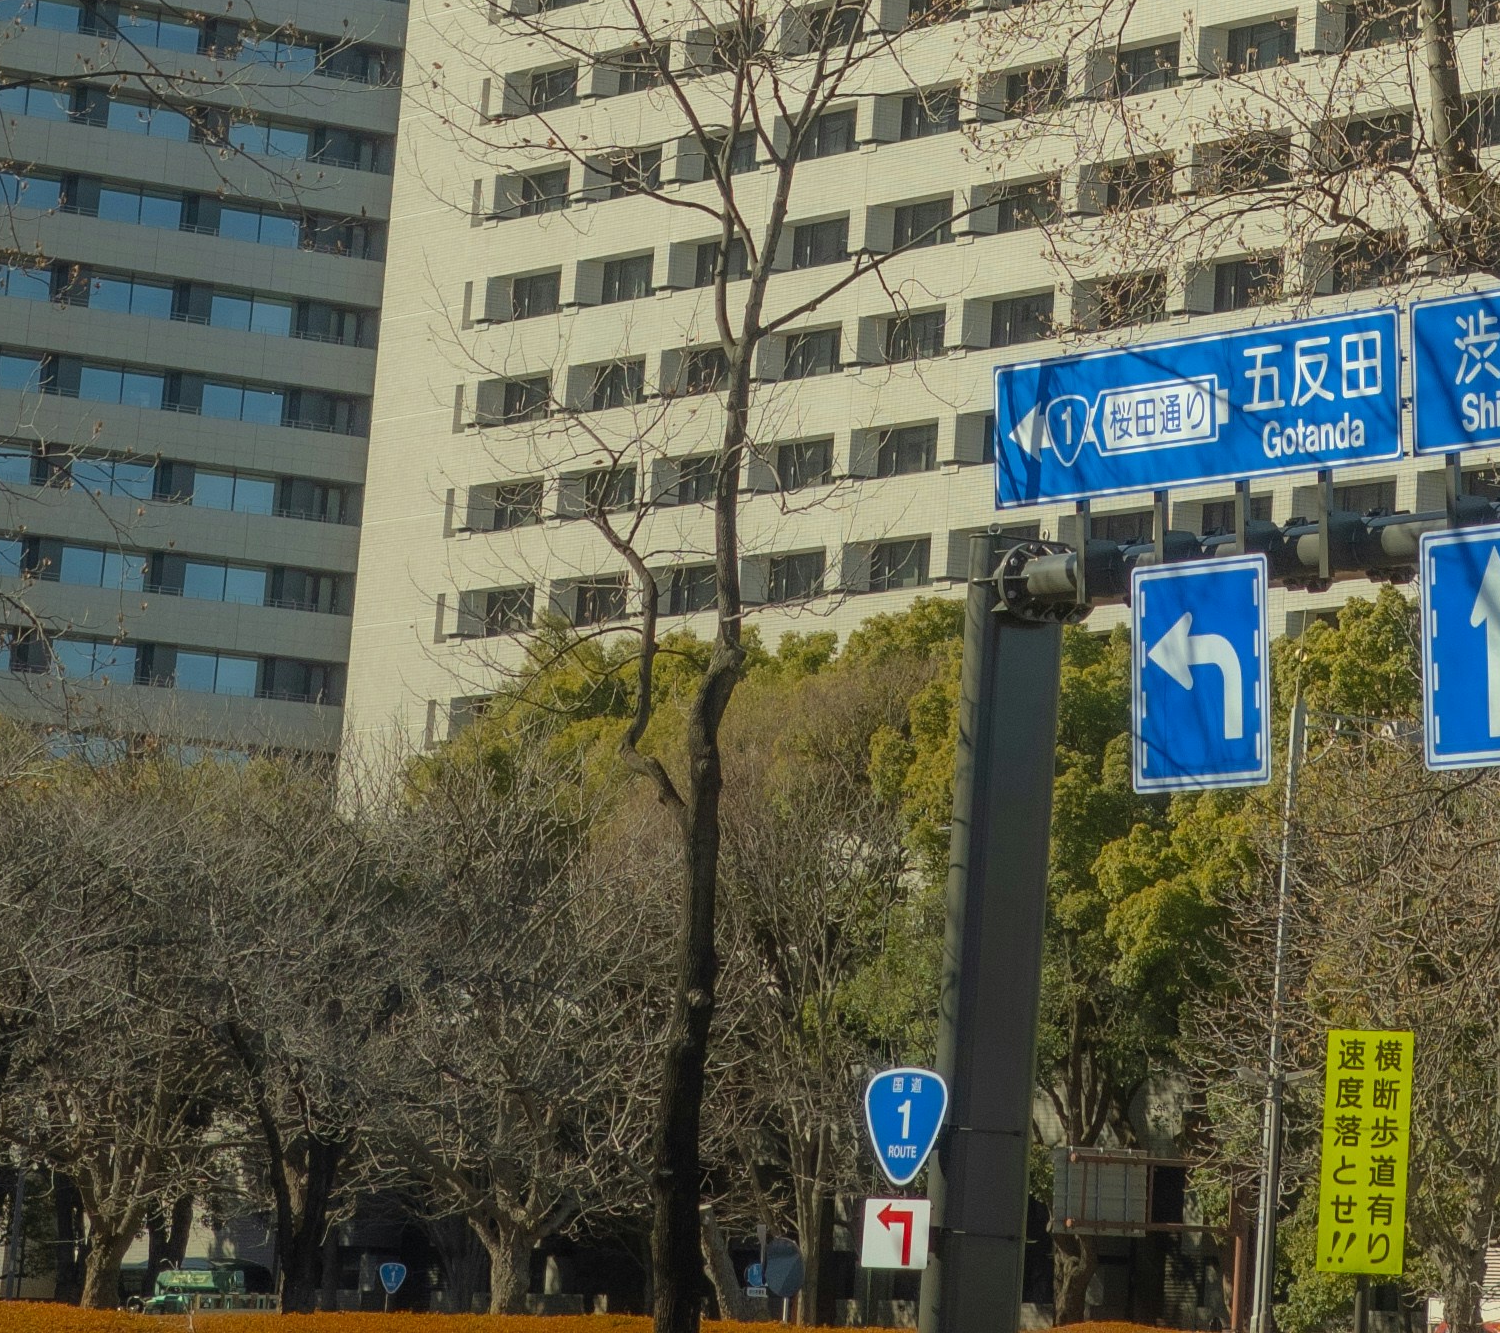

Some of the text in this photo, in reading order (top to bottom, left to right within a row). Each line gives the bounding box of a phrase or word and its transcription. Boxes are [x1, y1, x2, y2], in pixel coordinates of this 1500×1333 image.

[1242, 330, 1382, 413] 五反田
[1061, 406, 1072, 445] 1
[1109, 390, 1206, 442] 桜田通り
[1262, 412, 1366, 459] Gotanda
[892, 1077, 923, 1093] 国道
[897, 1099, 912, 1140] 1
[888, 1144, 917, 1159] ROUTE
[1367, 1038, 1403, 1264] 横断歩道有り
